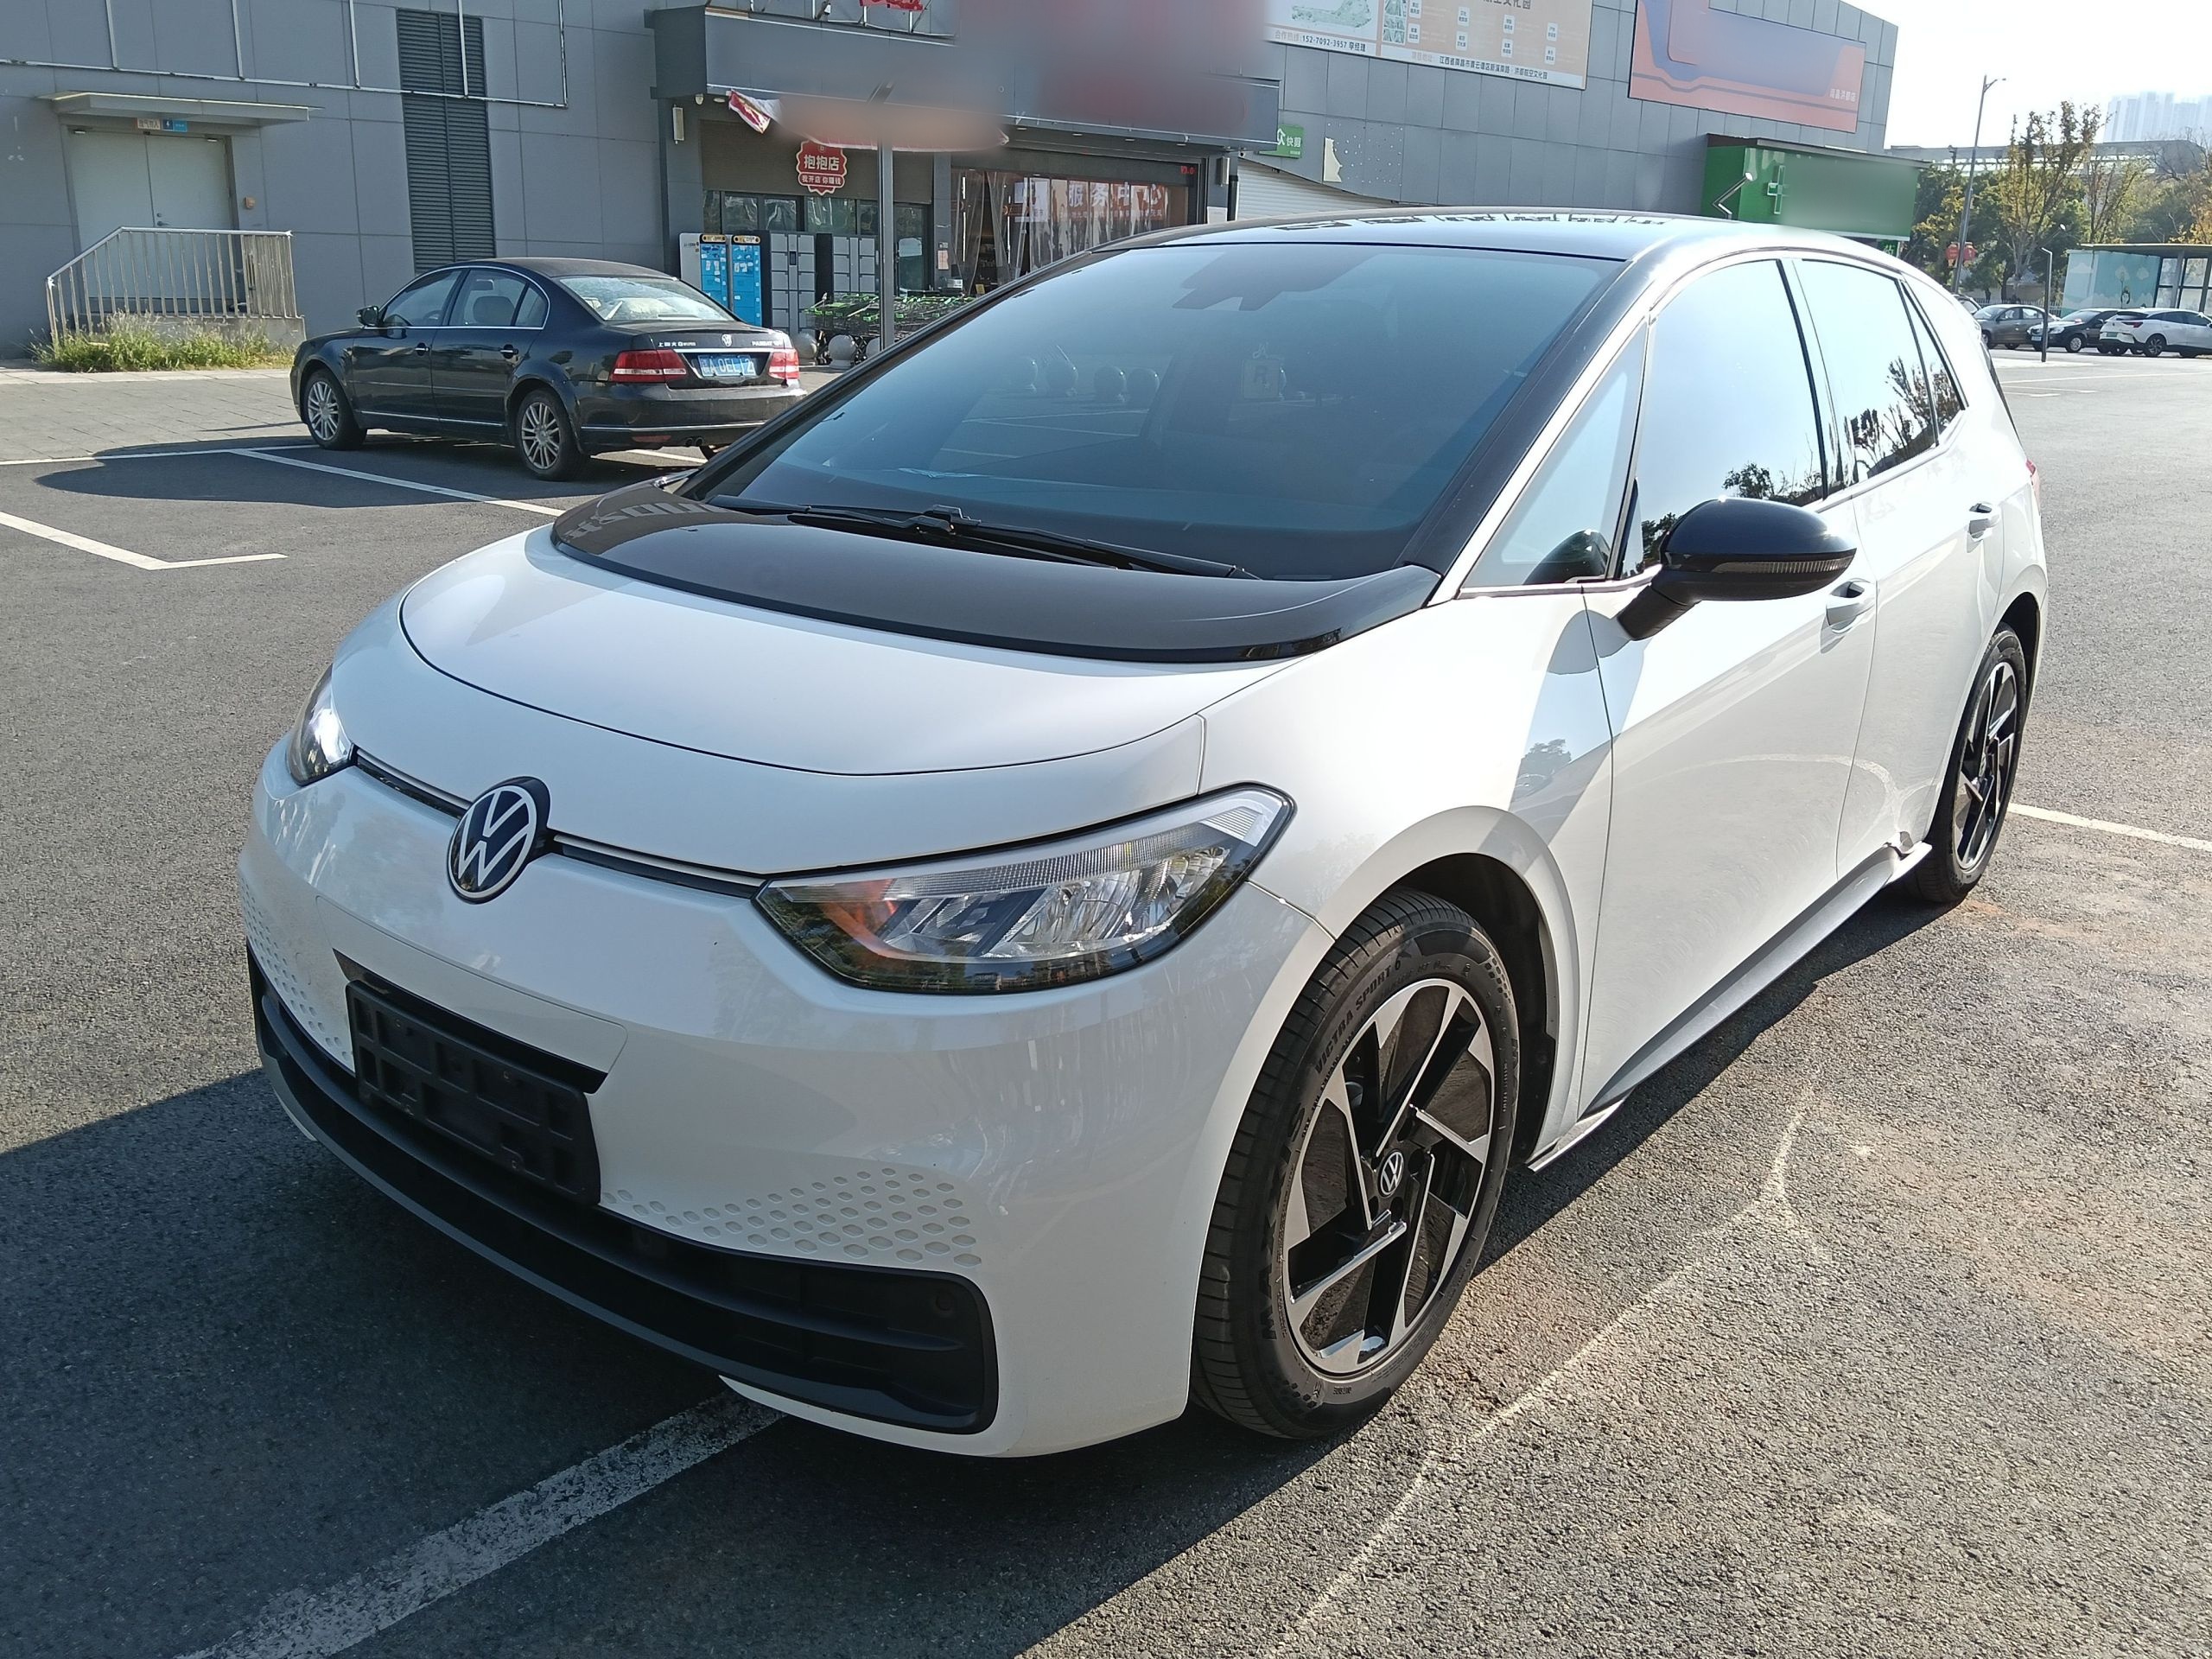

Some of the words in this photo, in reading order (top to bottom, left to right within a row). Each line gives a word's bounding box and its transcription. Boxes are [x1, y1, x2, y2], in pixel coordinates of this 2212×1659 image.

[1302, 35, 1347, 48] 152-7092-3957
[804, 154, 840, 171] 抱抱店
[1069, 181, 1162, 208] 服务中心
[1314, 1010, 1354, 1074] VICTRA
[1354, 964, 1392, 1011] SPORT
[1394, 954, 1402, 971] 6
